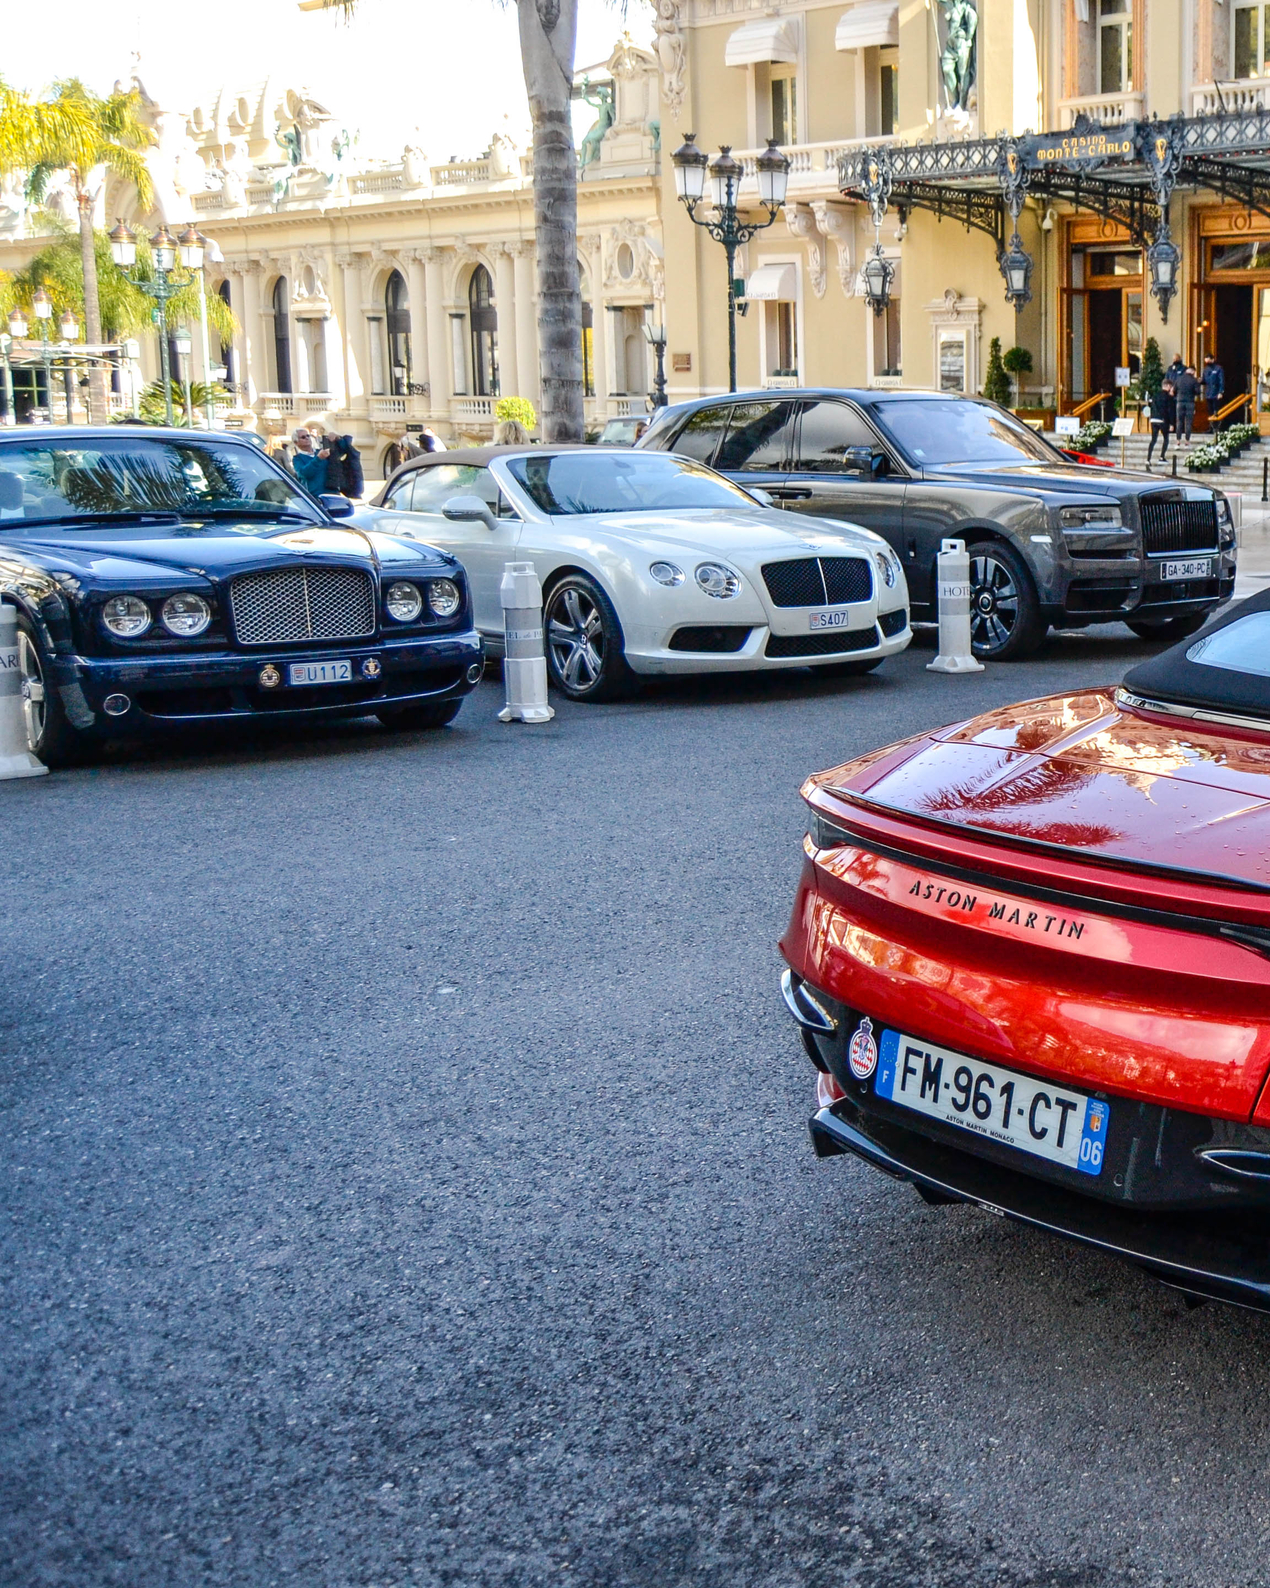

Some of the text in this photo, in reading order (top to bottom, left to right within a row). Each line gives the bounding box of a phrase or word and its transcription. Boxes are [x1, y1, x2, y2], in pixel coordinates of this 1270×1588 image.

[1062, 135, 1106, 148] CASINO
[820, 612, 846, 626] S407
[307, 664, 349, 681] U112
[909, 880, 1085, 939] ASTON MARTIN
[882, 1070, 890, 1083] F
[900, 1046, 1078, 1149] FM-961-CT
[946, 1115, 1015, 1144] ASTON MARTIN MONACO
[1080, 1137, 1103, 1166] 06
